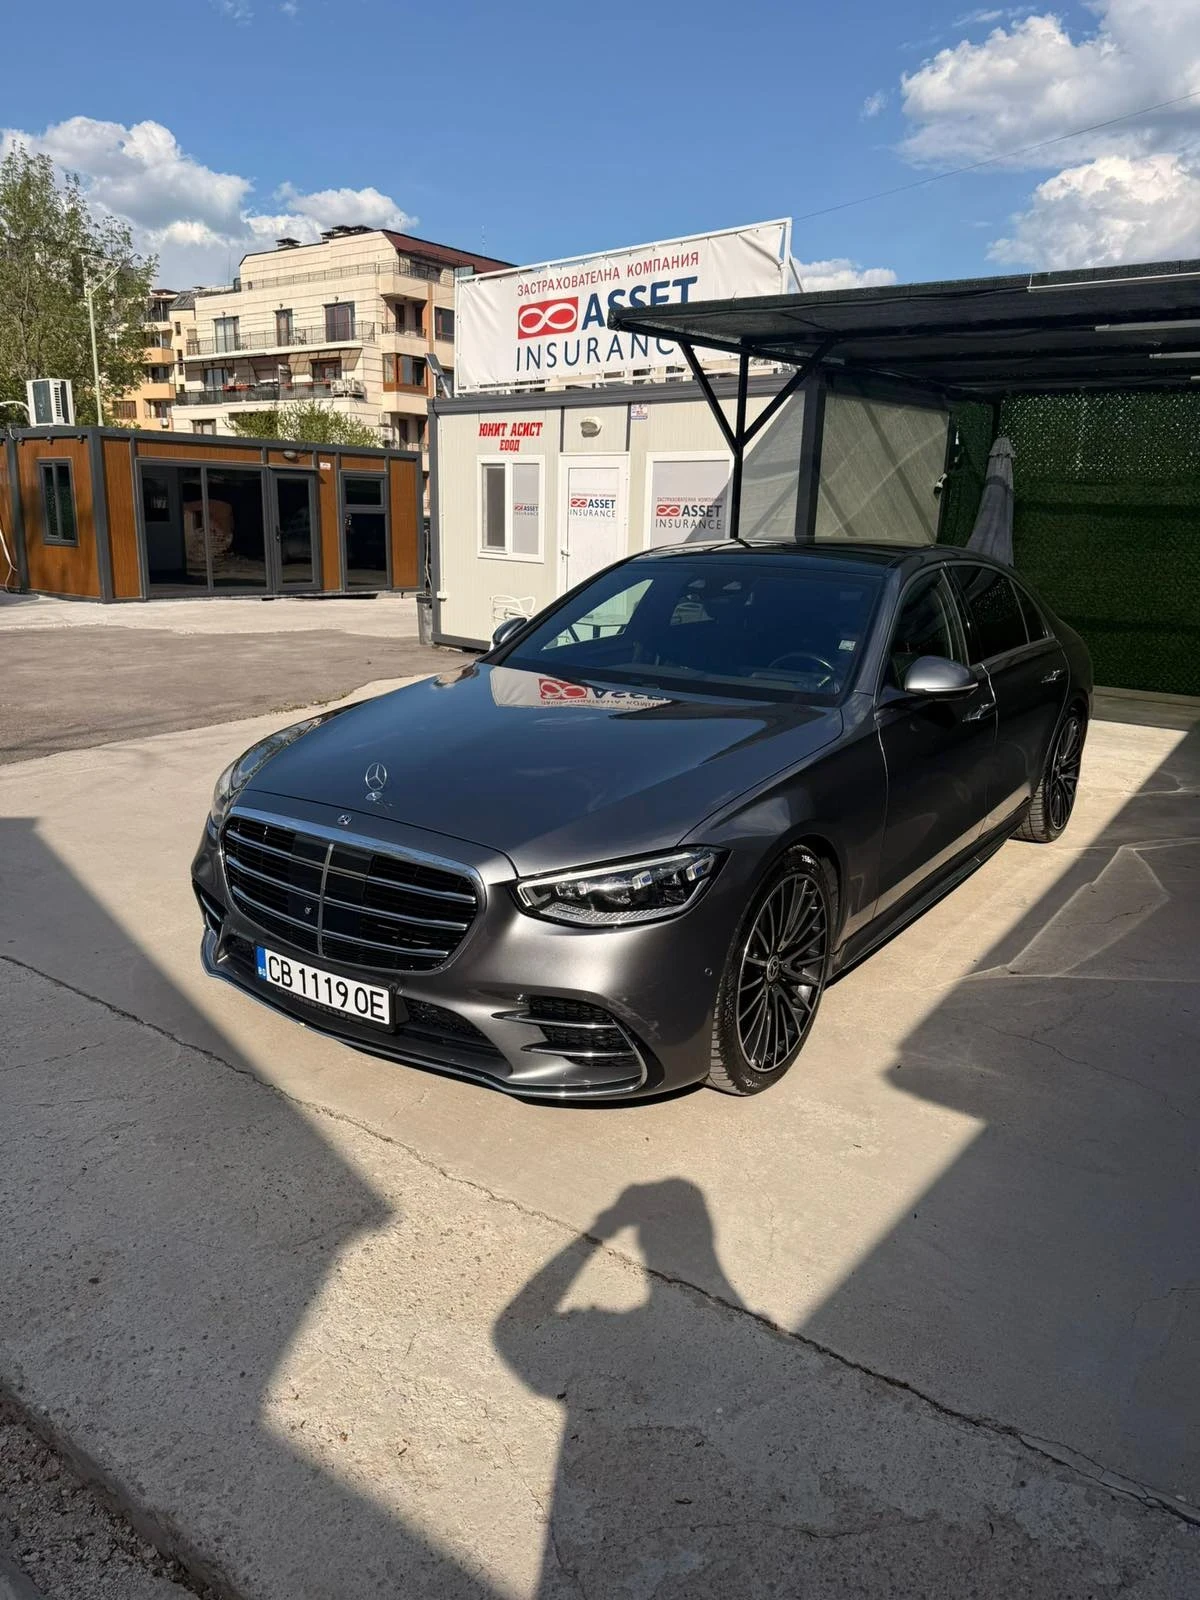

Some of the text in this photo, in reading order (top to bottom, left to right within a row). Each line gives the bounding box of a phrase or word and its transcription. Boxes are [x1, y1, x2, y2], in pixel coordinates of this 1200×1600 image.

[517, 251, 699, 297] ЗАСТРАХОВАТЕЛНА КОМПАНИЯ
[516, 333, 695, 372] INSURANC
[479, 422, 543, 437] ЮНИТ АСИСТ
[499, 439, 520, 452] ЕООД
[588, 499, 616, 509] ASSET
[570, 509, 616, 518] INSURANCE
[681, 504, 722, 518] ASSET
[655, 518, 723, 530] INSURANCE
